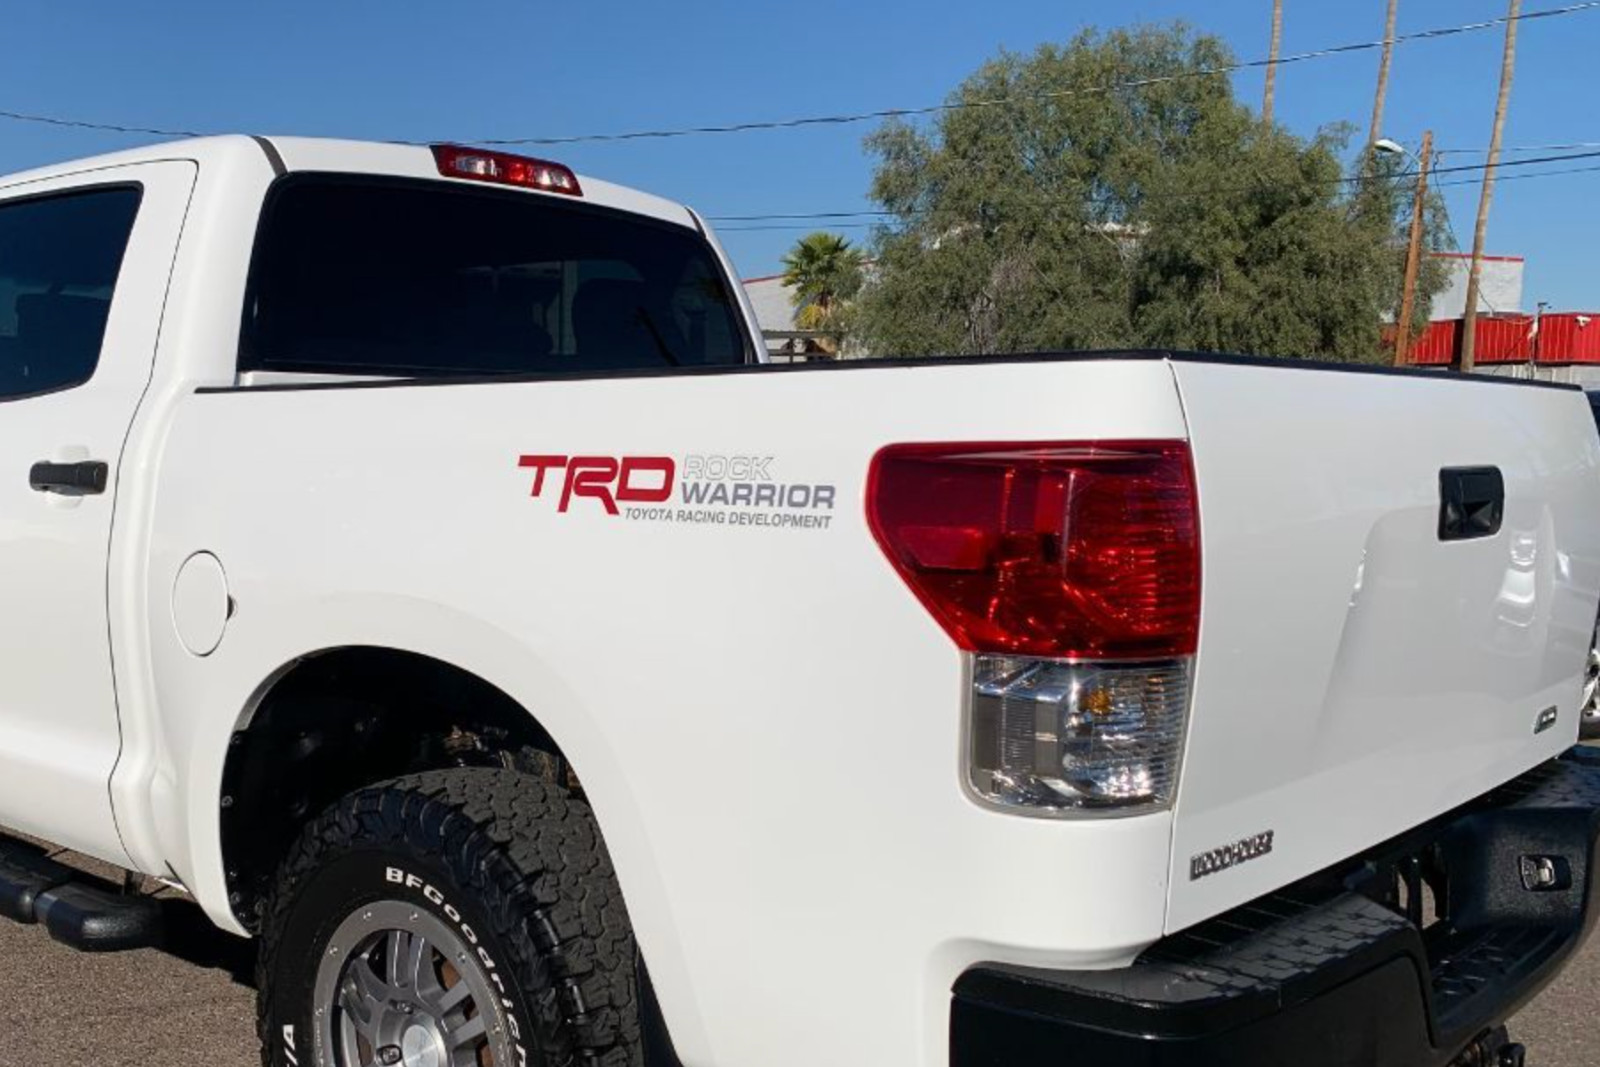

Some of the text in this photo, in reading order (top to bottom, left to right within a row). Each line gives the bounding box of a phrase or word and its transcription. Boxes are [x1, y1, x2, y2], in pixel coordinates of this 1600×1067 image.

[682, 454, 774, 481] ROCK
[518, 455, 675, 515] TRD
[681, 481, 836, 509] WARRIOR
[625, 507, 832, 529] TOYOTA RACING DEVELOPMENT
